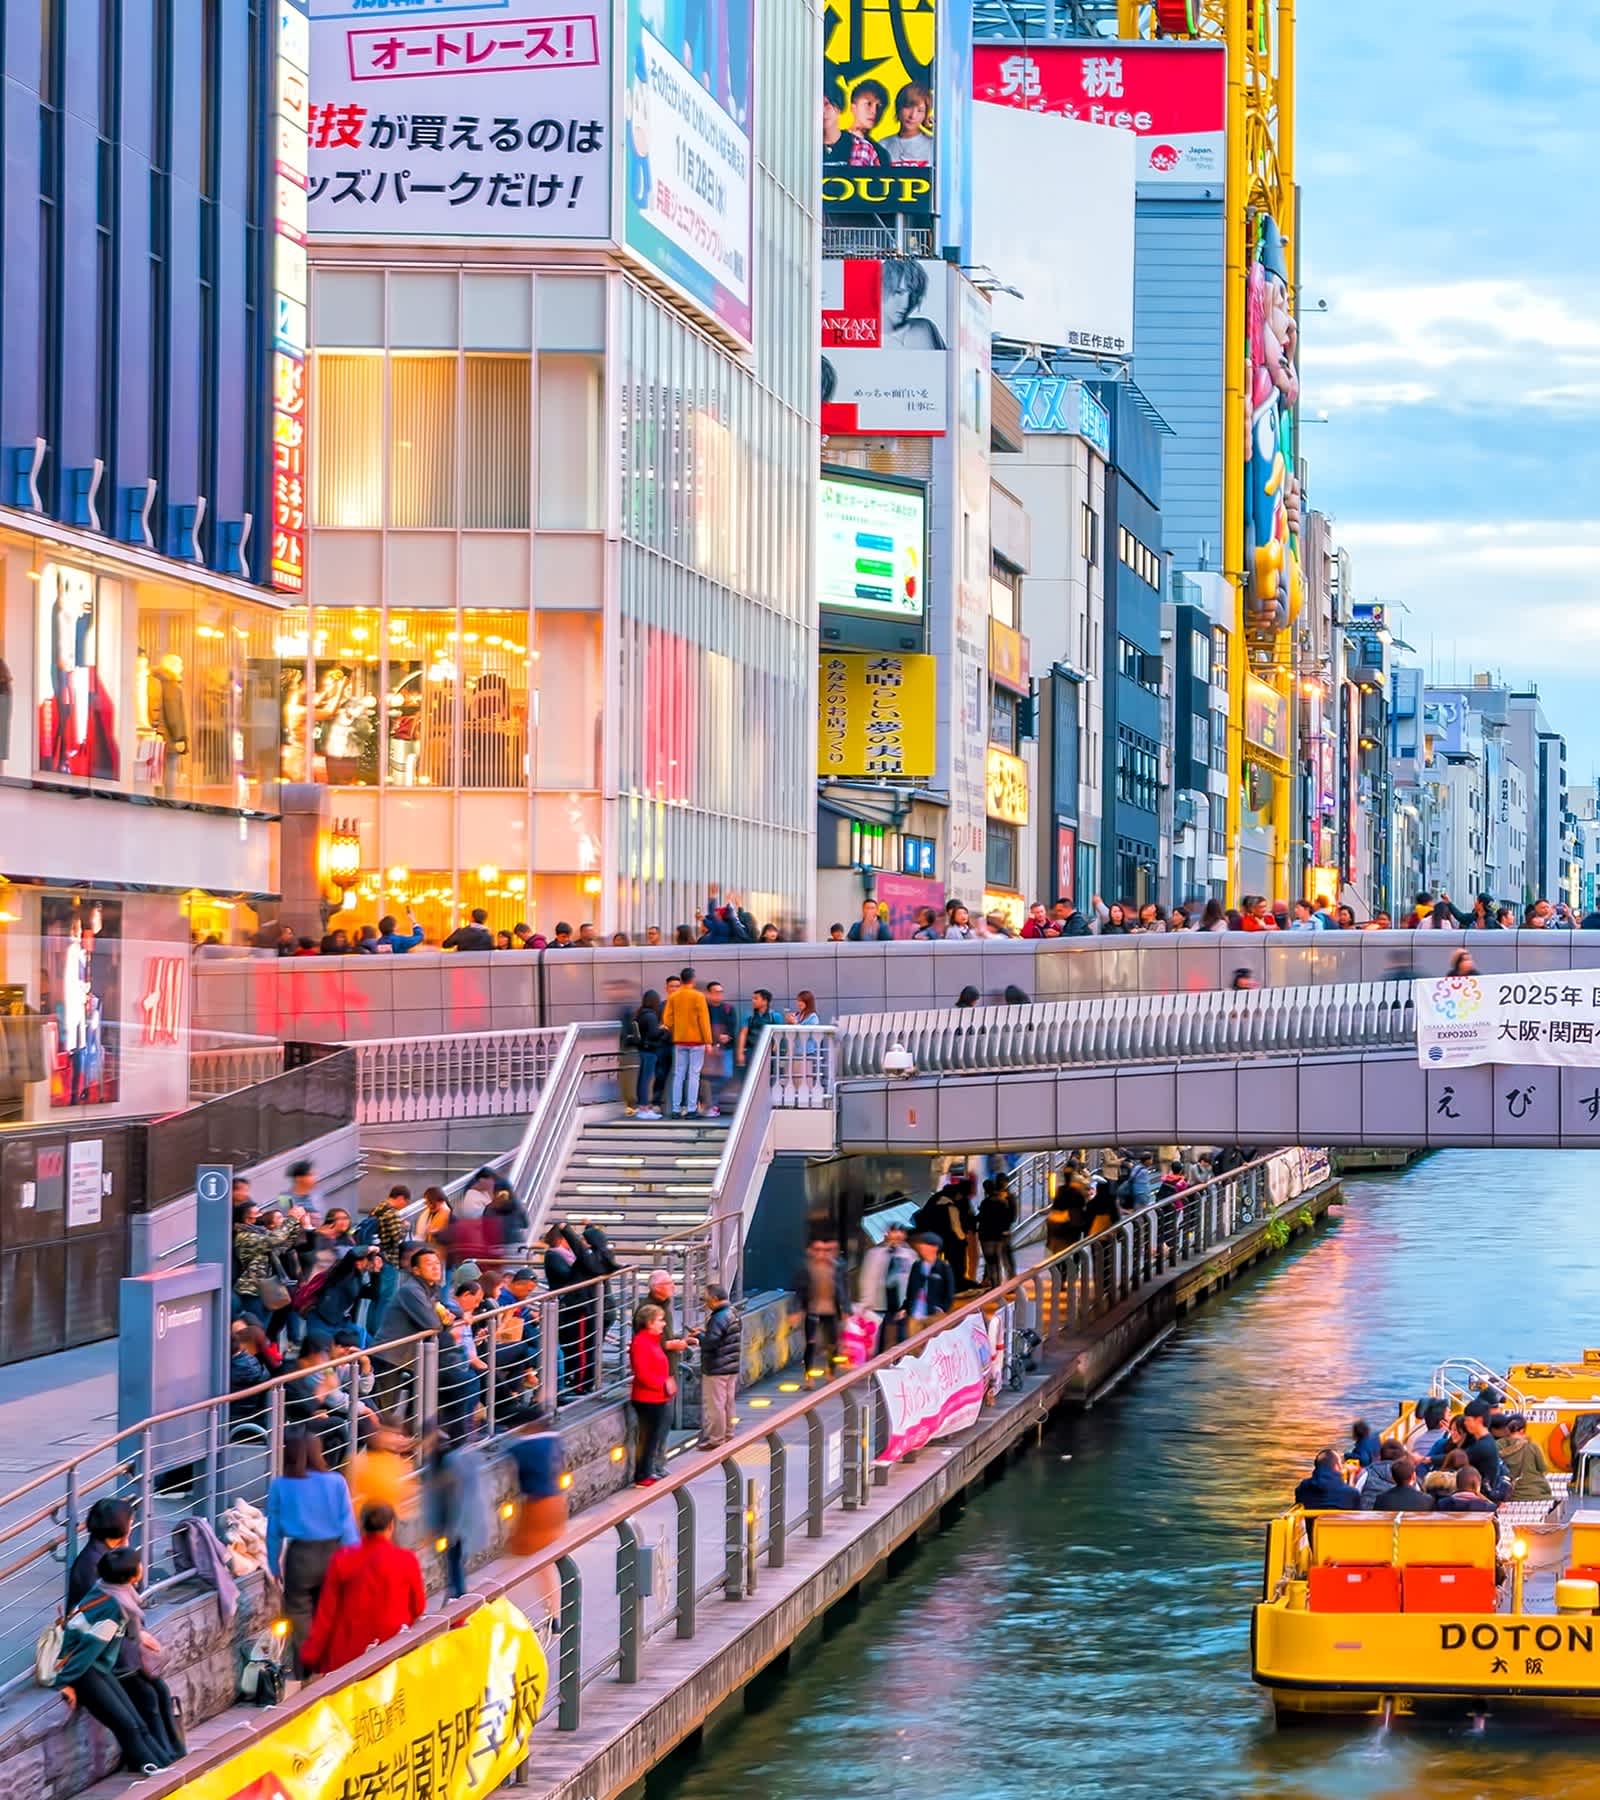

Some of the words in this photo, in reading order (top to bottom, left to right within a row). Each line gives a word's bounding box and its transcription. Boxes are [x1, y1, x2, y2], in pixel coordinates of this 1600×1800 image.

[371, 25, 574, 70] オートレース!
[1000, 56, 1125, 98] 免税
[308, 102, 604, 153] 技が買えるのは
[1067, 330, 1125, 351] 意匠作成中
[1498, 984, 1584, 1008] 2025年
[1440, 1623, 1594, 1653] DOTON
[1490, 1657, 1545, 1676] 大阪
